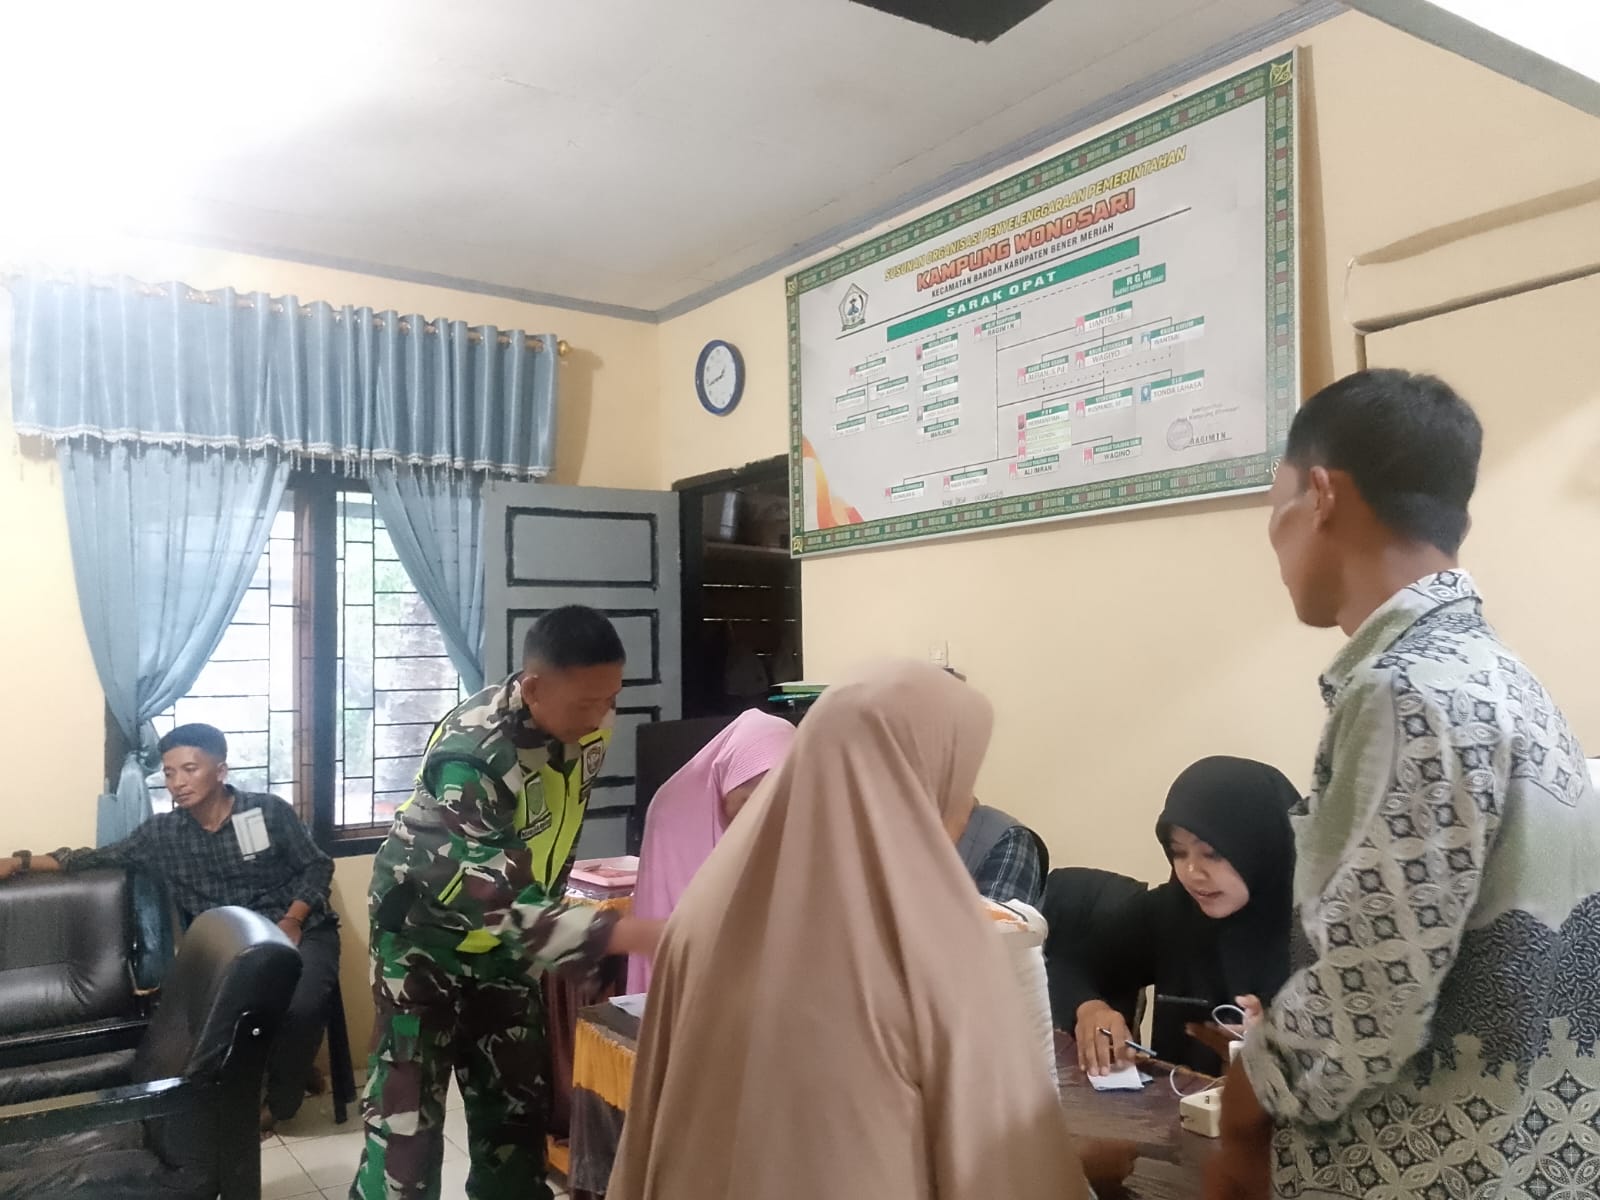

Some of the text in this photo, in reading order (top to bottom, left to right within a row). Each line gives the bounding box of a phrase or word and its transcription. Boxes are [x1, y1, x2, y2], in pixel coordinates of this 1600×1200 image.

[885, 145, 1187, 281] SUSUNAN ORGANISASI PENYELENGGARAAN PEMERINTAHAN
[916, 188, 1136, 292] KAMPUNG WONOSARI
[931, 222, 1114, 297] KECAMATAN BANDAR KABUPATEN BENER MERIAH
[947, 271, 1057, 318] SARAK OPAT
